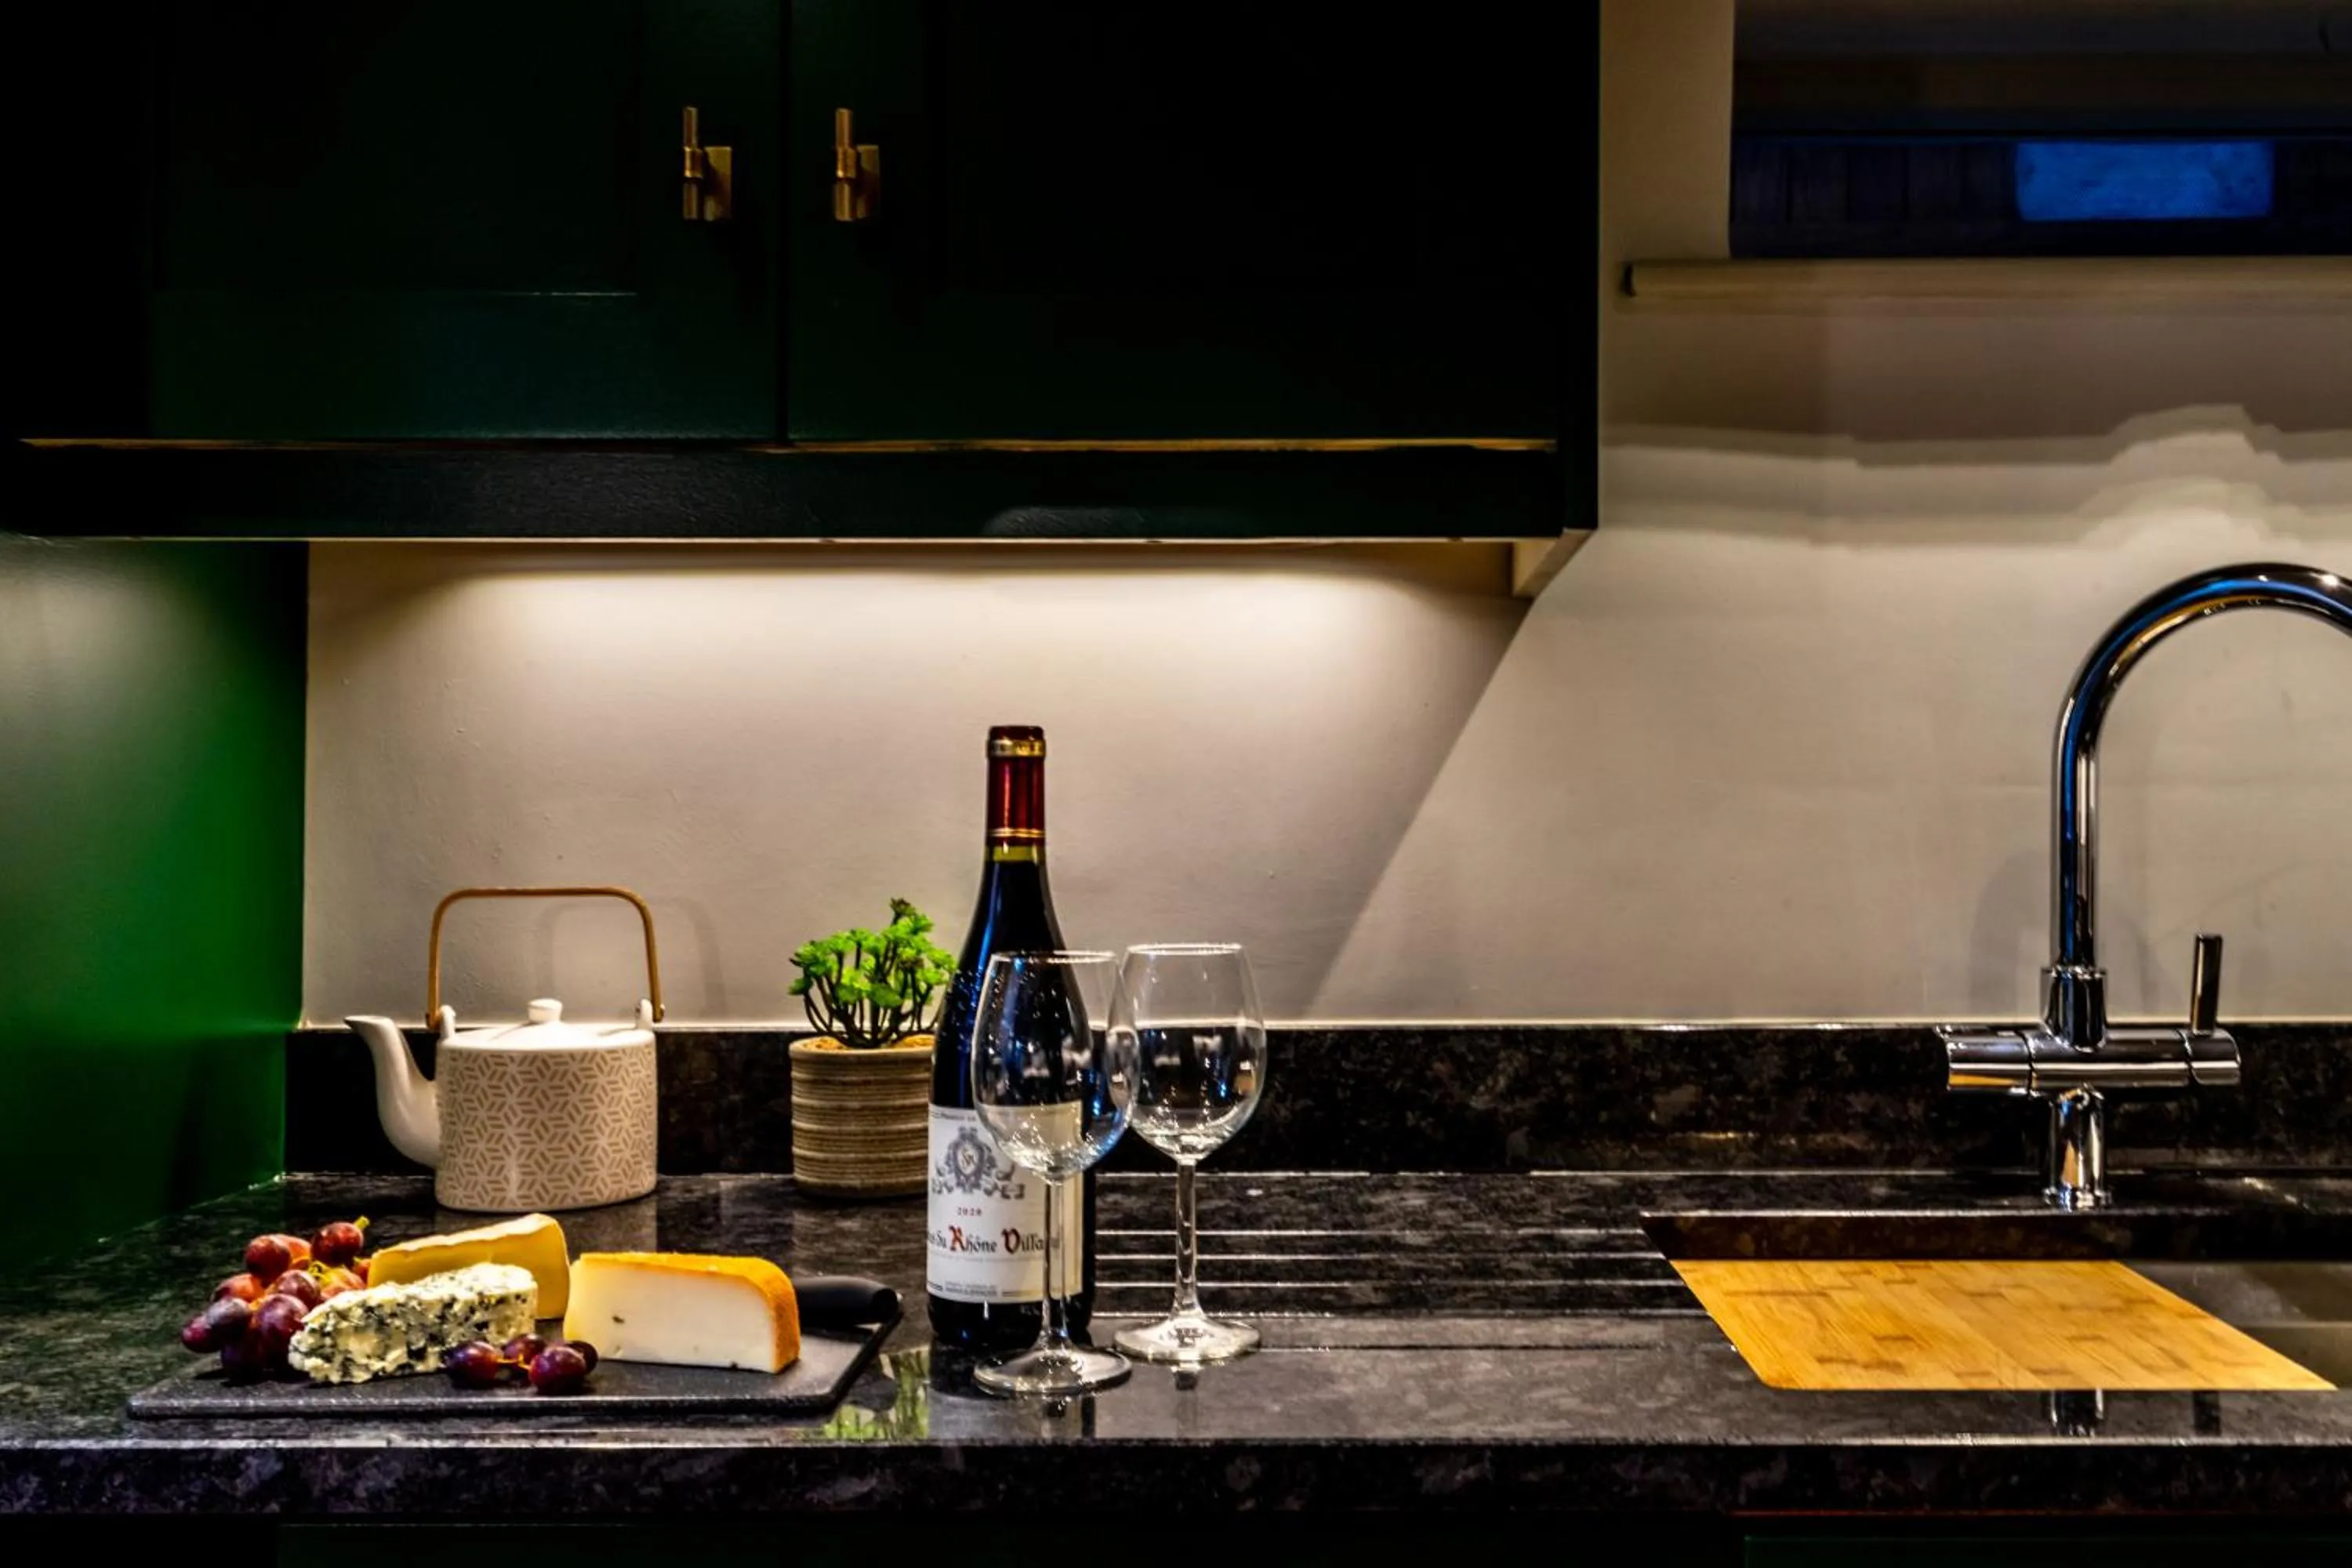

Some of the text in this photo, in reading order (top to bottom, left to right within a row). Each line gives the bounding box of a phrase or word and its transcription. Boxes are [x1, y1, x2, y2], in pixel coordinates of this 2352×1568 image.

[956, 1207, 982, 1216] 2020
[948, 1225, 998, 1253] Rhône
[1001, 1228, 1061, 1254] Villa
